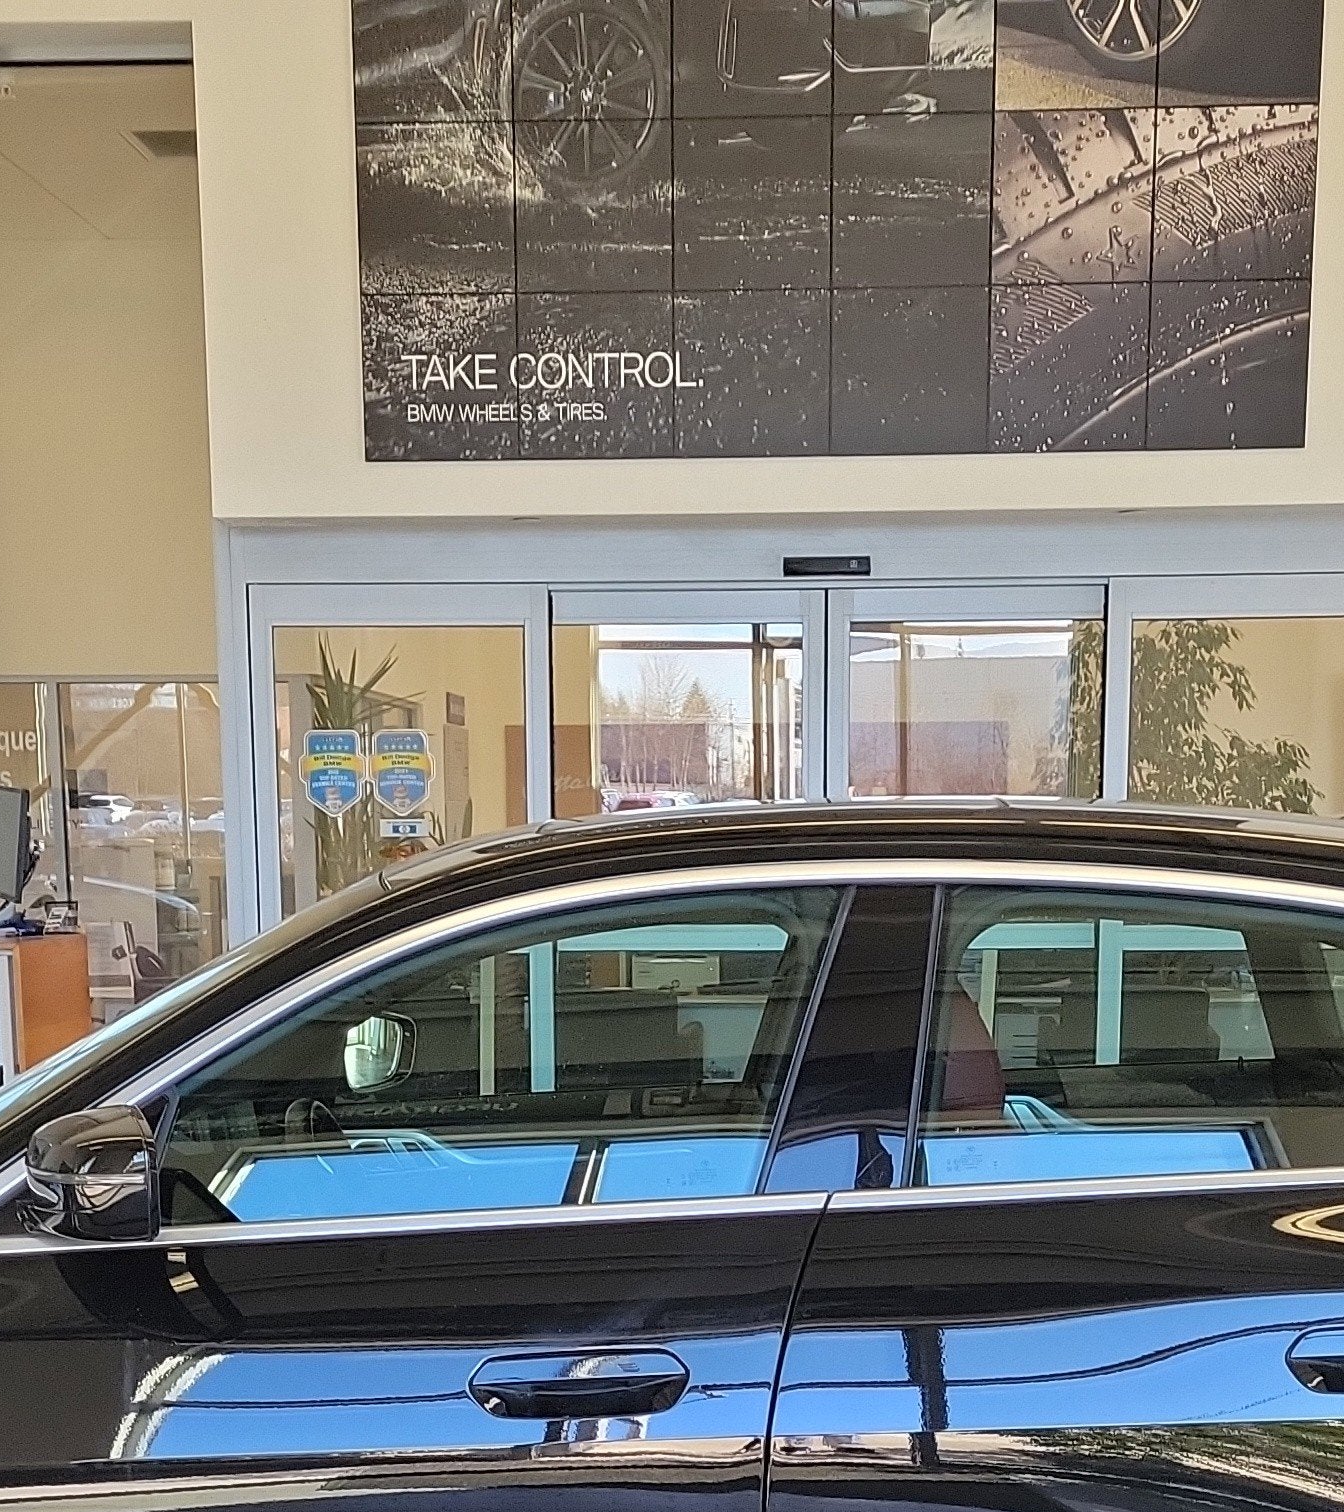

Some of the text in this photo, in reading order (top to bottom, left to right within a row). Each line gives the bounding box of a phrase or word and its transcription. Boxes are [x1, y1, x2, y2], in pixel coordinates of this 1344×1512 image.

[400, 350, 705, 391] TAKE CONTROL.
[406, 401, 609, 423] BMW WHEELS & TIRES.
